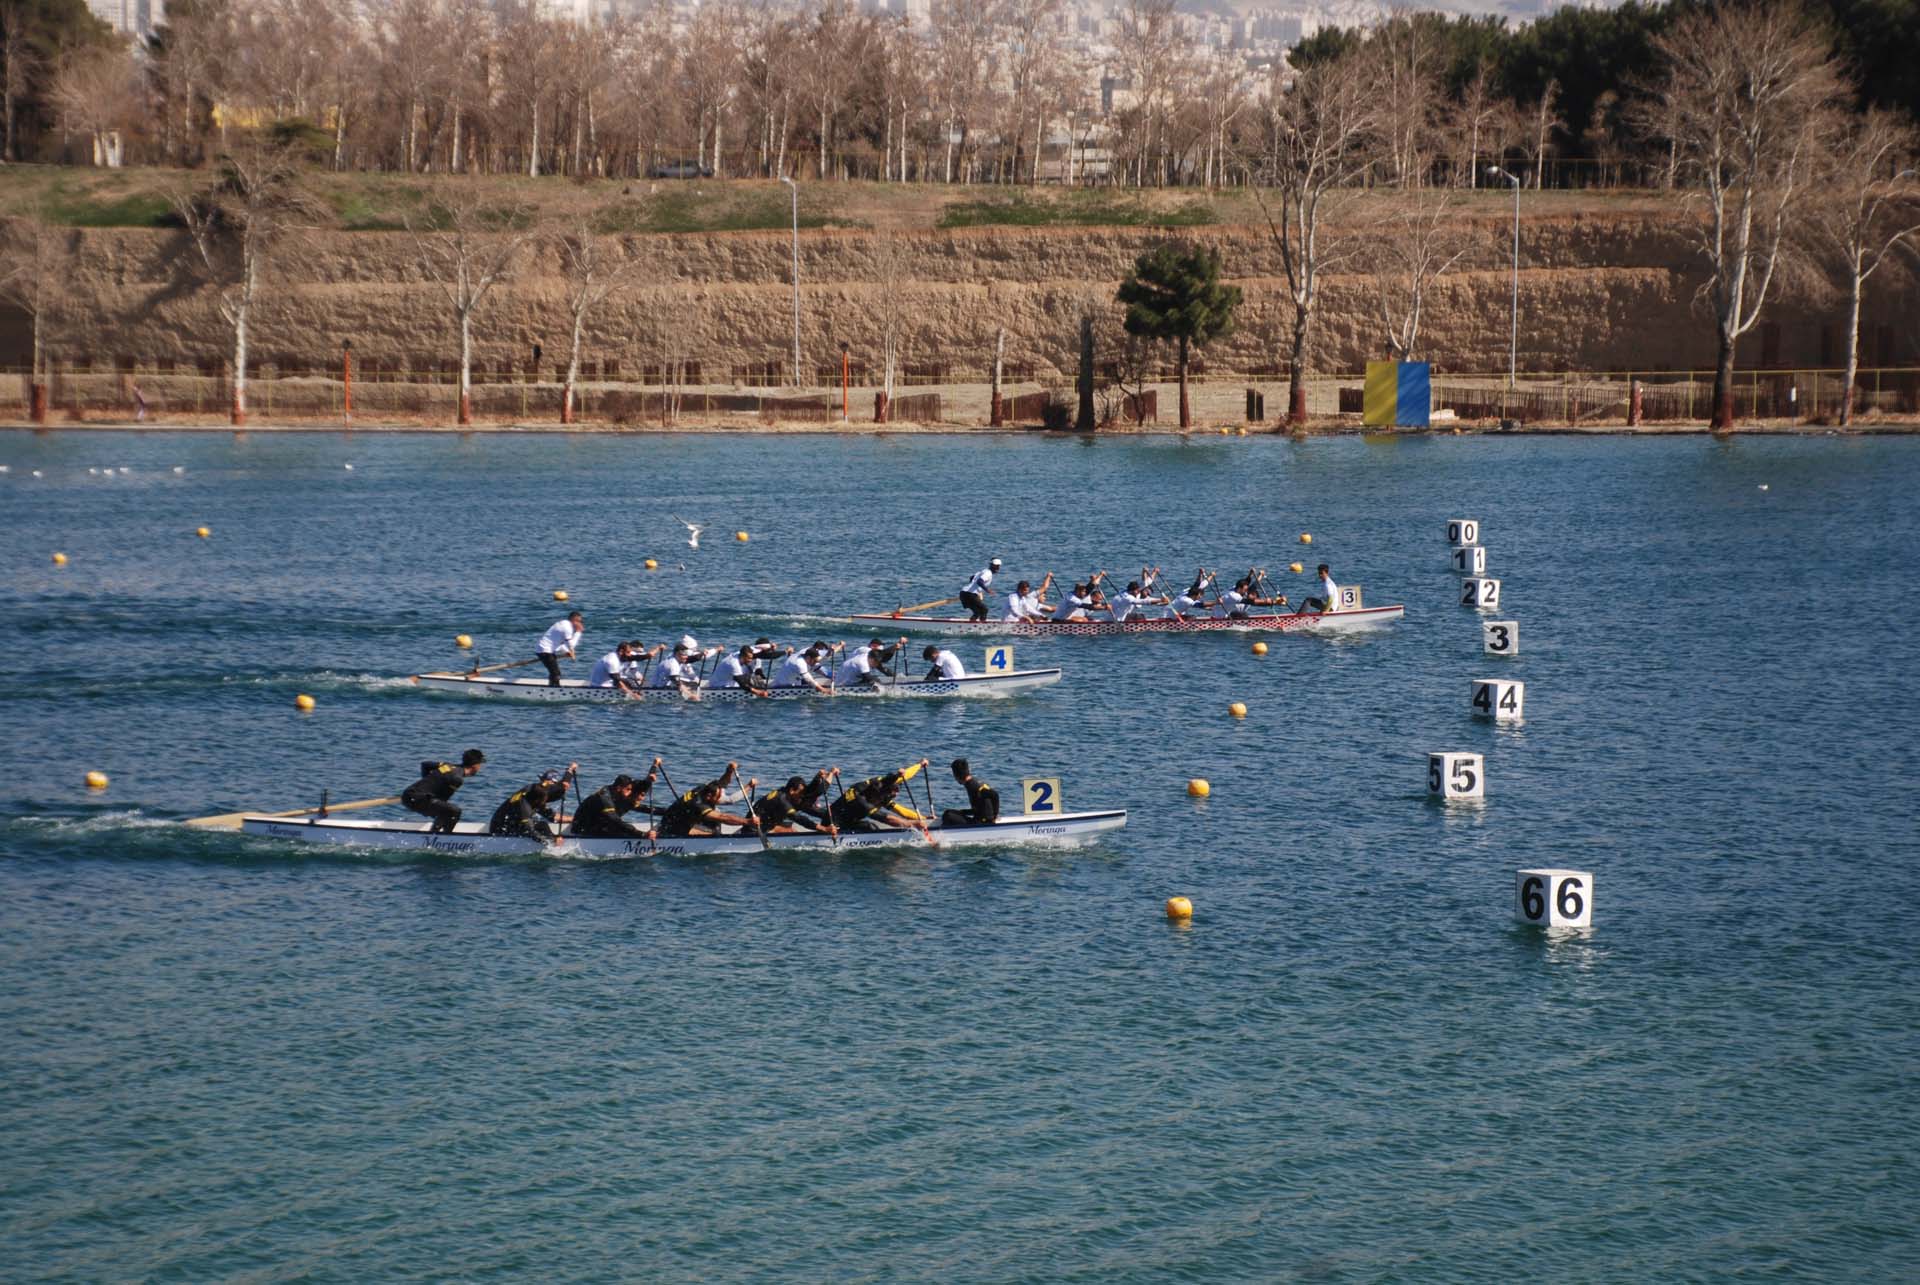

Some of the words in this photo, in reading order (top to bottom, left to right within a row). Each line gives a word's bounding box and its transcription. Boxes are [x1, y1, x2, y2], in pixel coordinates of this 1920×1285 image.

[1448, 523, 1459, 541] 0
[1464, 523, 1474, 541] 0
[1455, 549, 1466, 570] 1
[1476, 549, 1482, 569] 1
[1345, 591, 1354, 603] 3
[1462, 581, 1476, 604] 2
[1483, 581, 1496, 603] 2
[1489, 625, 1510, 651] 3
[990, 649, 1006, 669] 4
[1473, 683, 1492, 713] 4
[1499, 685, 1517, 714] 4
[1429, 757, 1441, 792] 5
[1451, 758, 1476, 793] 5
[1030, 782, 1053, 812] 2
[1521, 877, 1544, 920] 6
[1556, 877, 1584, 920] 6
